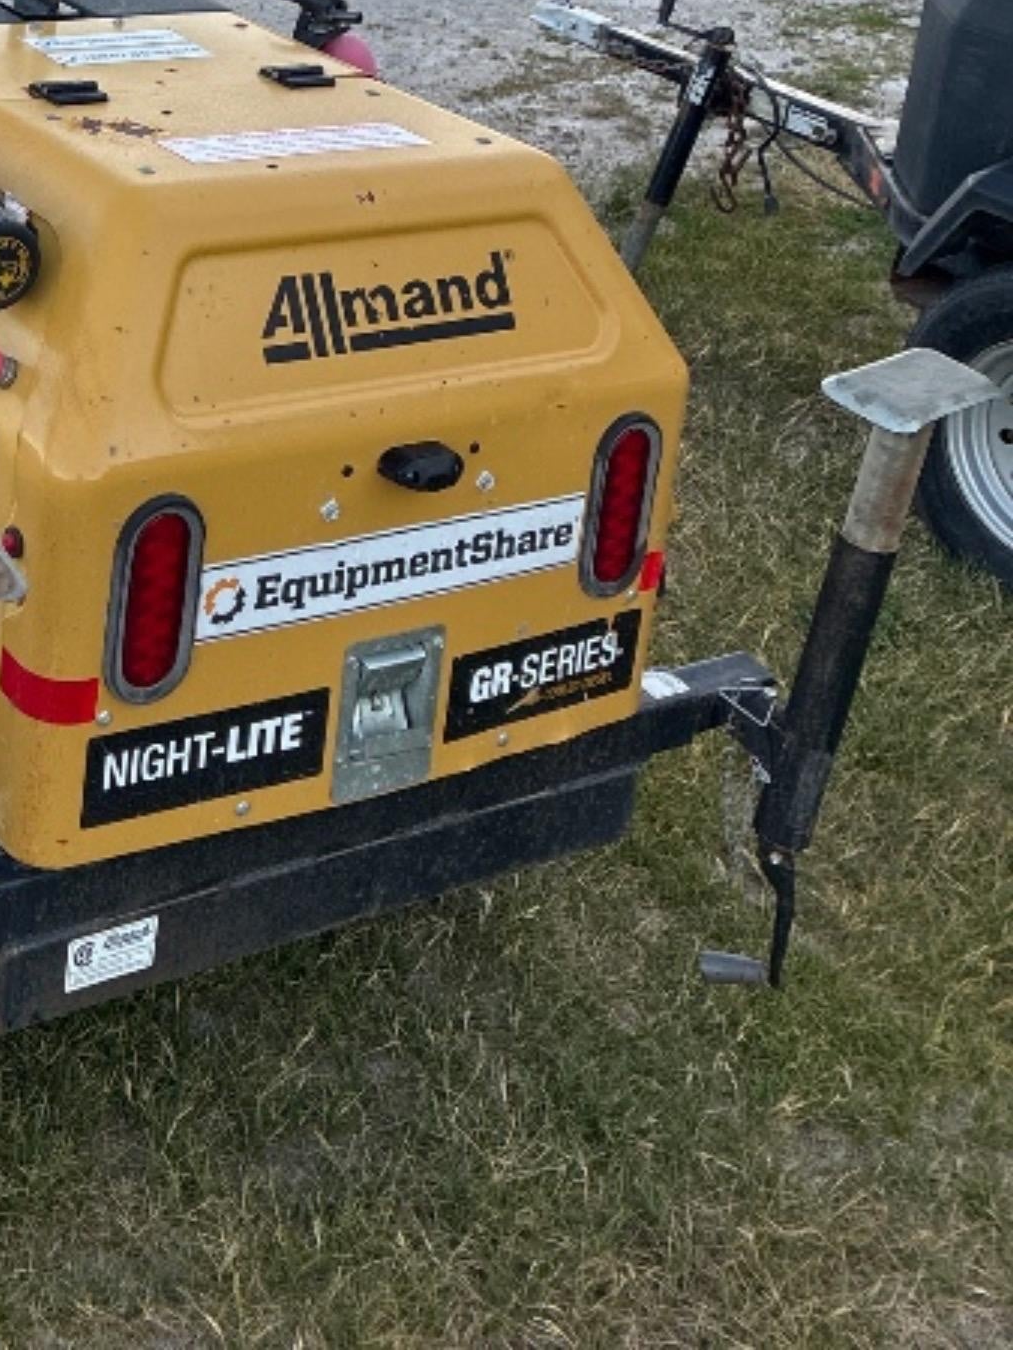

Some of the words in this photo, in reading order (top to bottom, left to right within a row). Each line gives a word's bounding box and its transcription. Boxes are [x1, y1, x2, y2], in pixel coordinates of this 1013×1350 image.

[261, 250, 511, 358] Allmand
[253, 522, 574, 614] EquipmentShare
[470, 631, 620, 703] GR-SERIES
[102, 712, 305, 791] NIGHT-LITE
